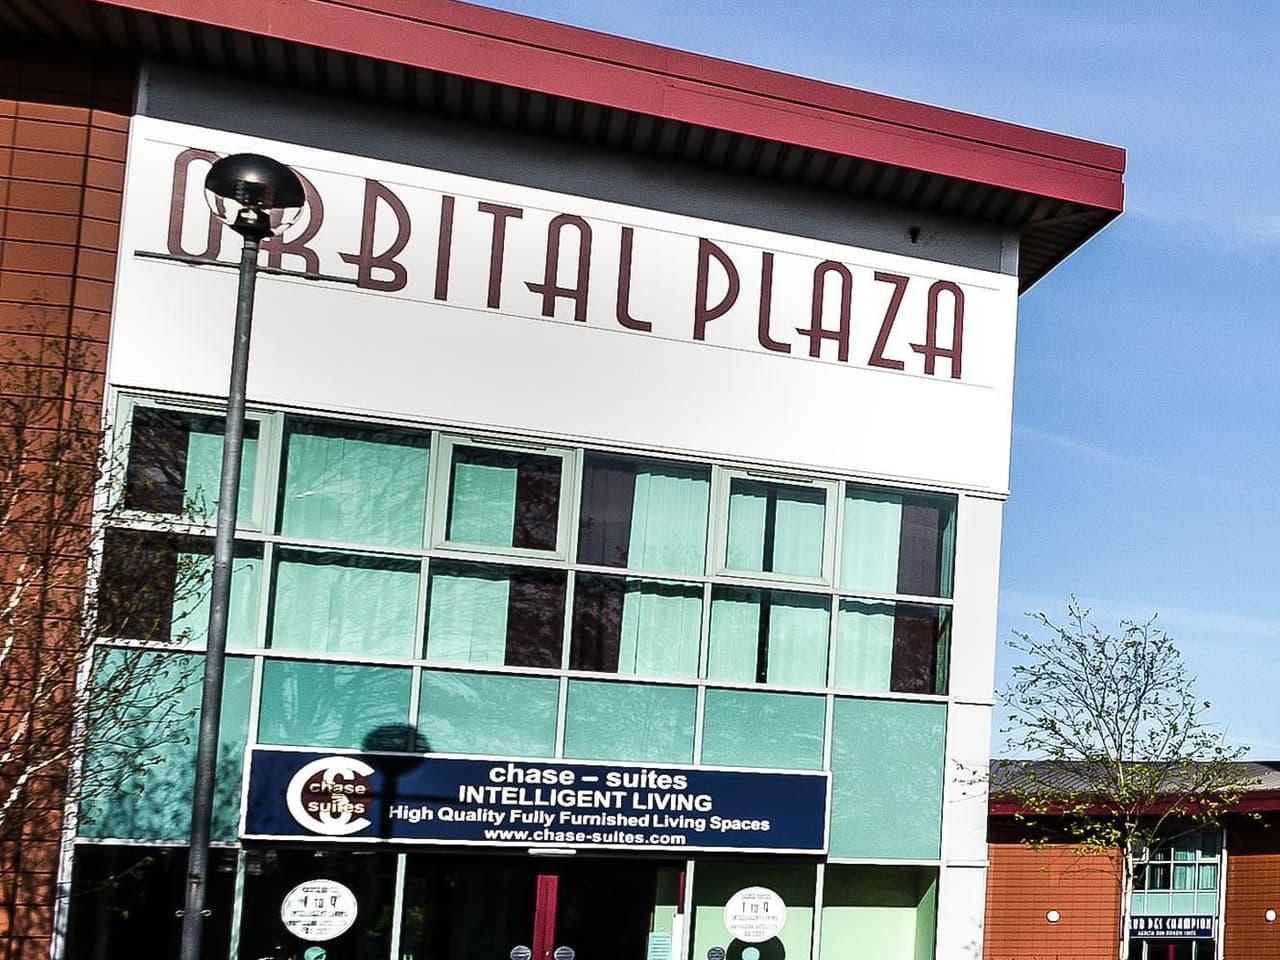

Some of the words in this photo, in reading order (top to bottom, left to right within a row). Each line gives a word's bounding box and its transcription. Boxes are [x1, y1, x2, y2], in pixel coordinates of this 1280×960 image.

[167, 146, 653, 333] ORBITAL
[693, 237, 965, 380] PLAZA
[309, 781, 367, 794] chase
[489, 763, 575, 785] chase
[606, 769, 688, 790] suites
[307, 800, 365, 814] suites
[458, 785, 628, 809] INTELLIGENT
[632, 792, 713, 812] LIVING
[389, 805, 434, 823] High
[437, 807, 505, 826] Quality
[509, 809, 555, 827] Fully
[559, 811, 650, 828] Furnished
[653, 814, 706, 831] Living
[709, 816, 771, 833] Spaces
[484, 828, 687, 845] www.chase-suites.com
